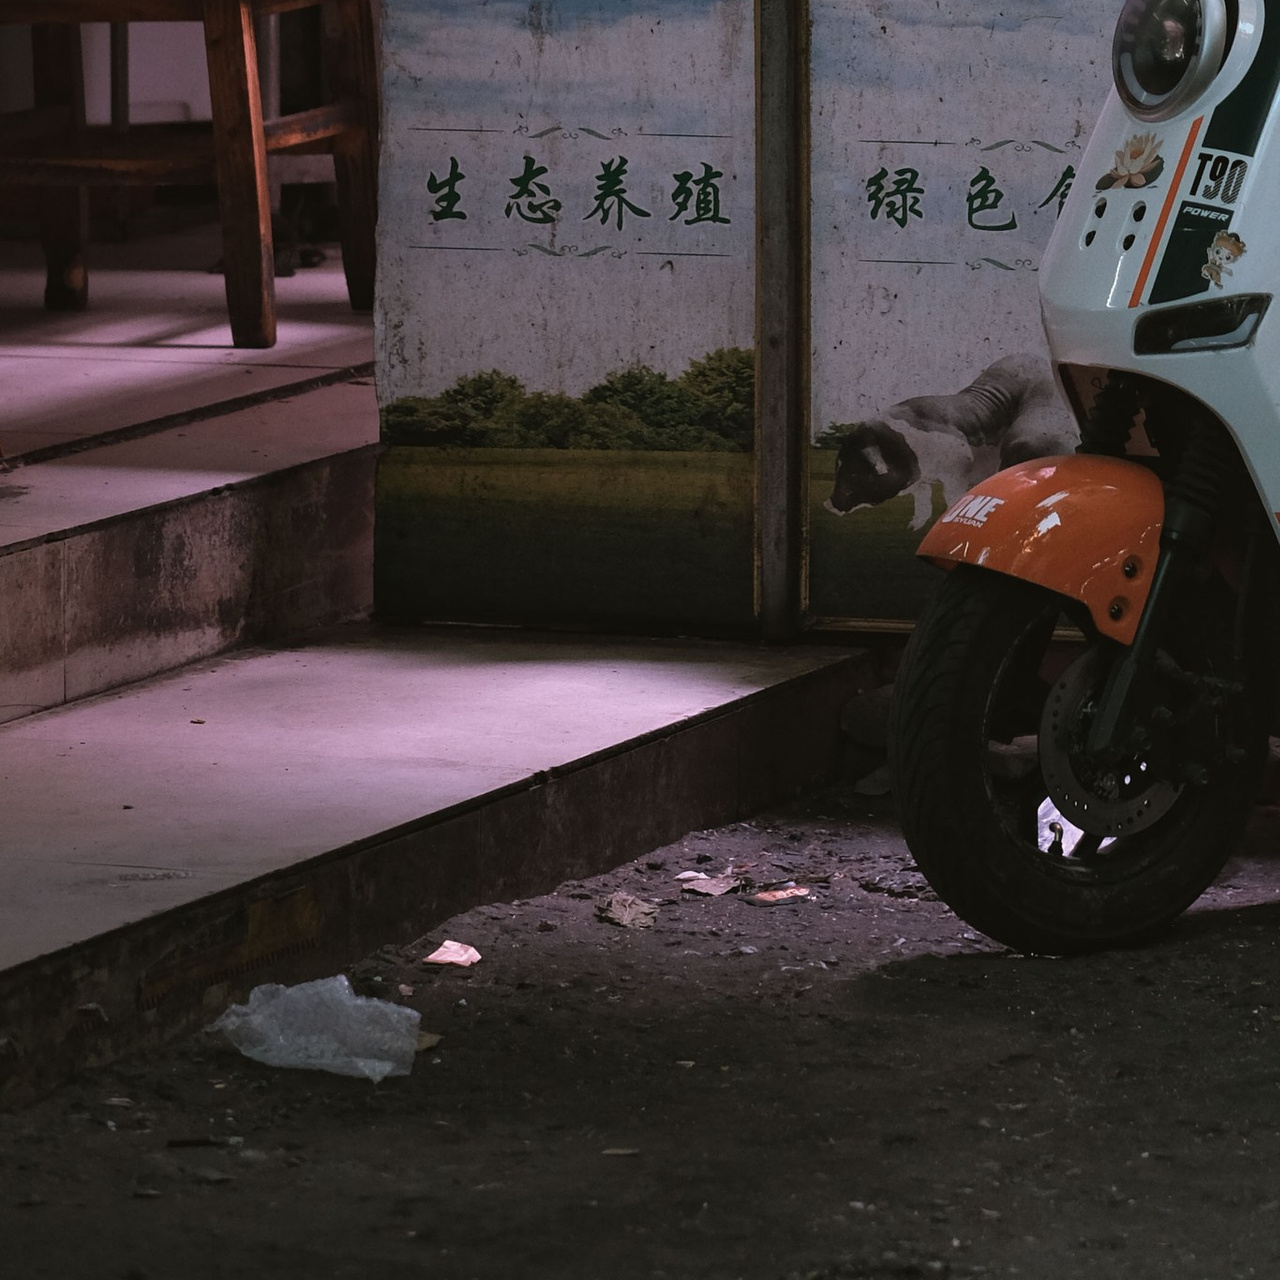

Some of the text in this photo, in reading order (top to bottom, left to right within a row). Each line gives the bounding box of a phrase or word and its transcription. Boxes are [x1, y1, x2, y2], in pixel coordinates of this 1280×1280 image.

[426, 155, 732, 227] 生态养殖
[1189, 152, 1248, 204] T90
[1182, 206, 1230, 223] POWER
